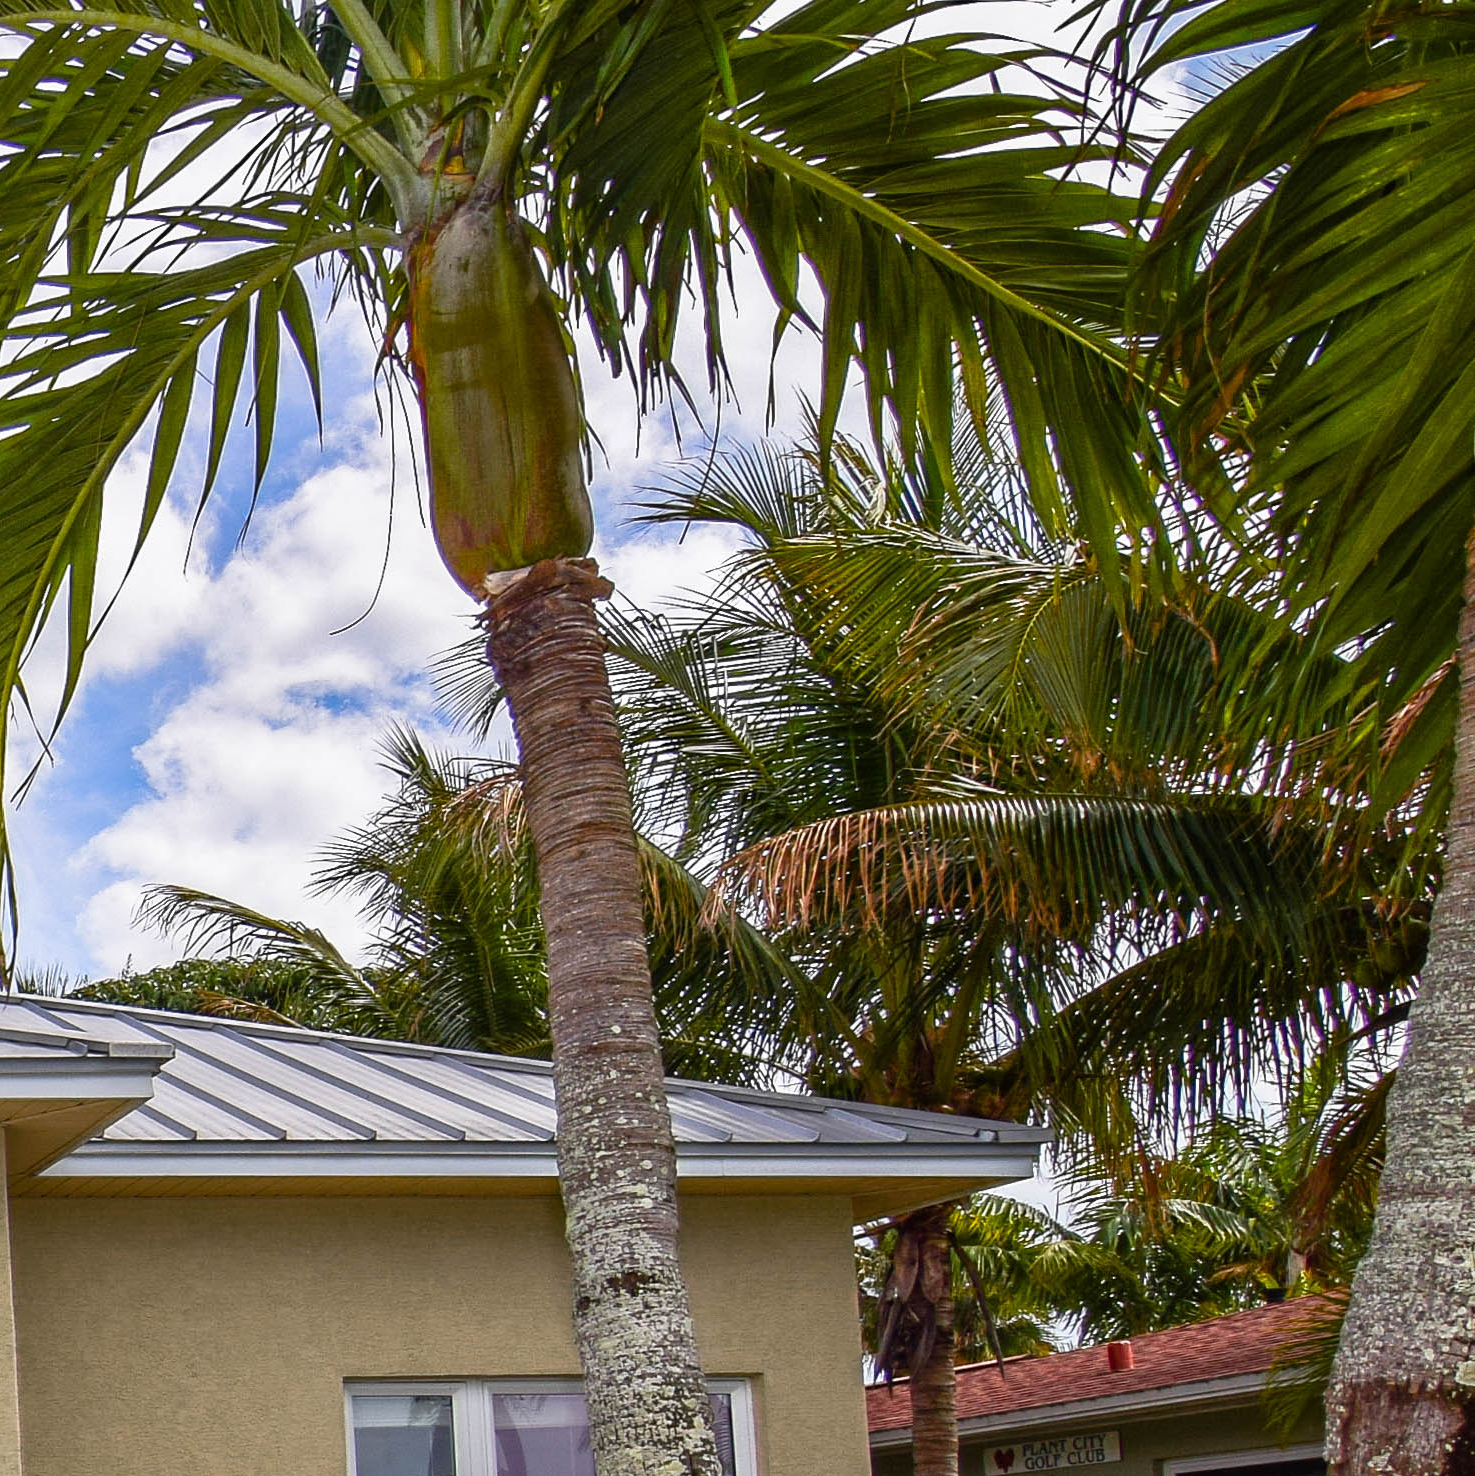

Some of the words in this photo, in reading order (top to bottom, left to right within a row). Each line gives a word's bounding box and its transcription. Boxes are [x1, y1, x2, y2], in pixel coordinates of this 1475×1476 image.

[1022, 1439, 1067, 1457] PLANT
[1072, 1434, 1106, 1450] CITY
[1025, 1454, 1061, 1470] GOLF
[1067, 1448, 1105, 1465] CLUB
